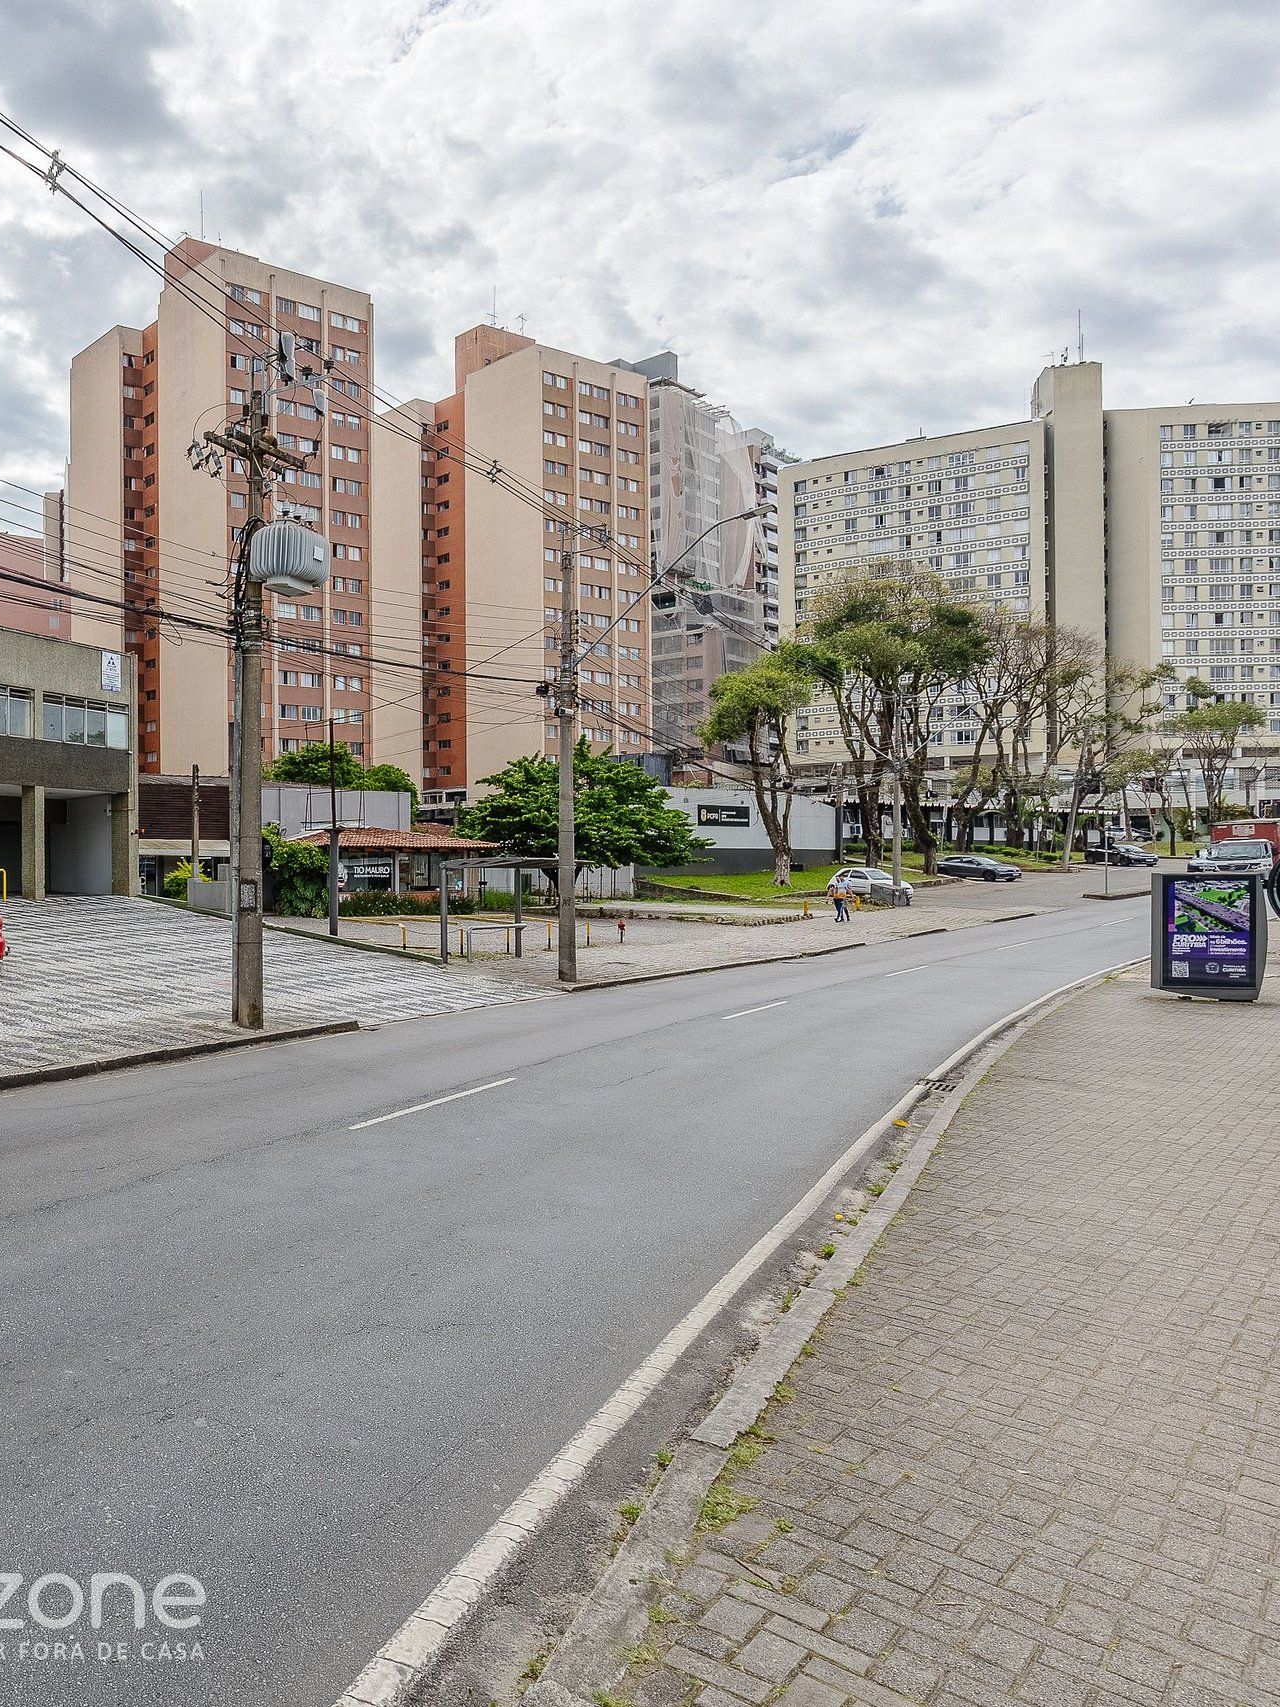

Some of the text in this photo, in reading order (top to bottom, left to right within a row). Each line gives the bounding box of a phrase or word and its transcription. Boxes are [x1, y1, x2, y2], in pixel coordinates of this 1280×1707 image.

[354, 866, 390, 874] TIO MAURO
[1173, 934, 1197, 942] PRO
